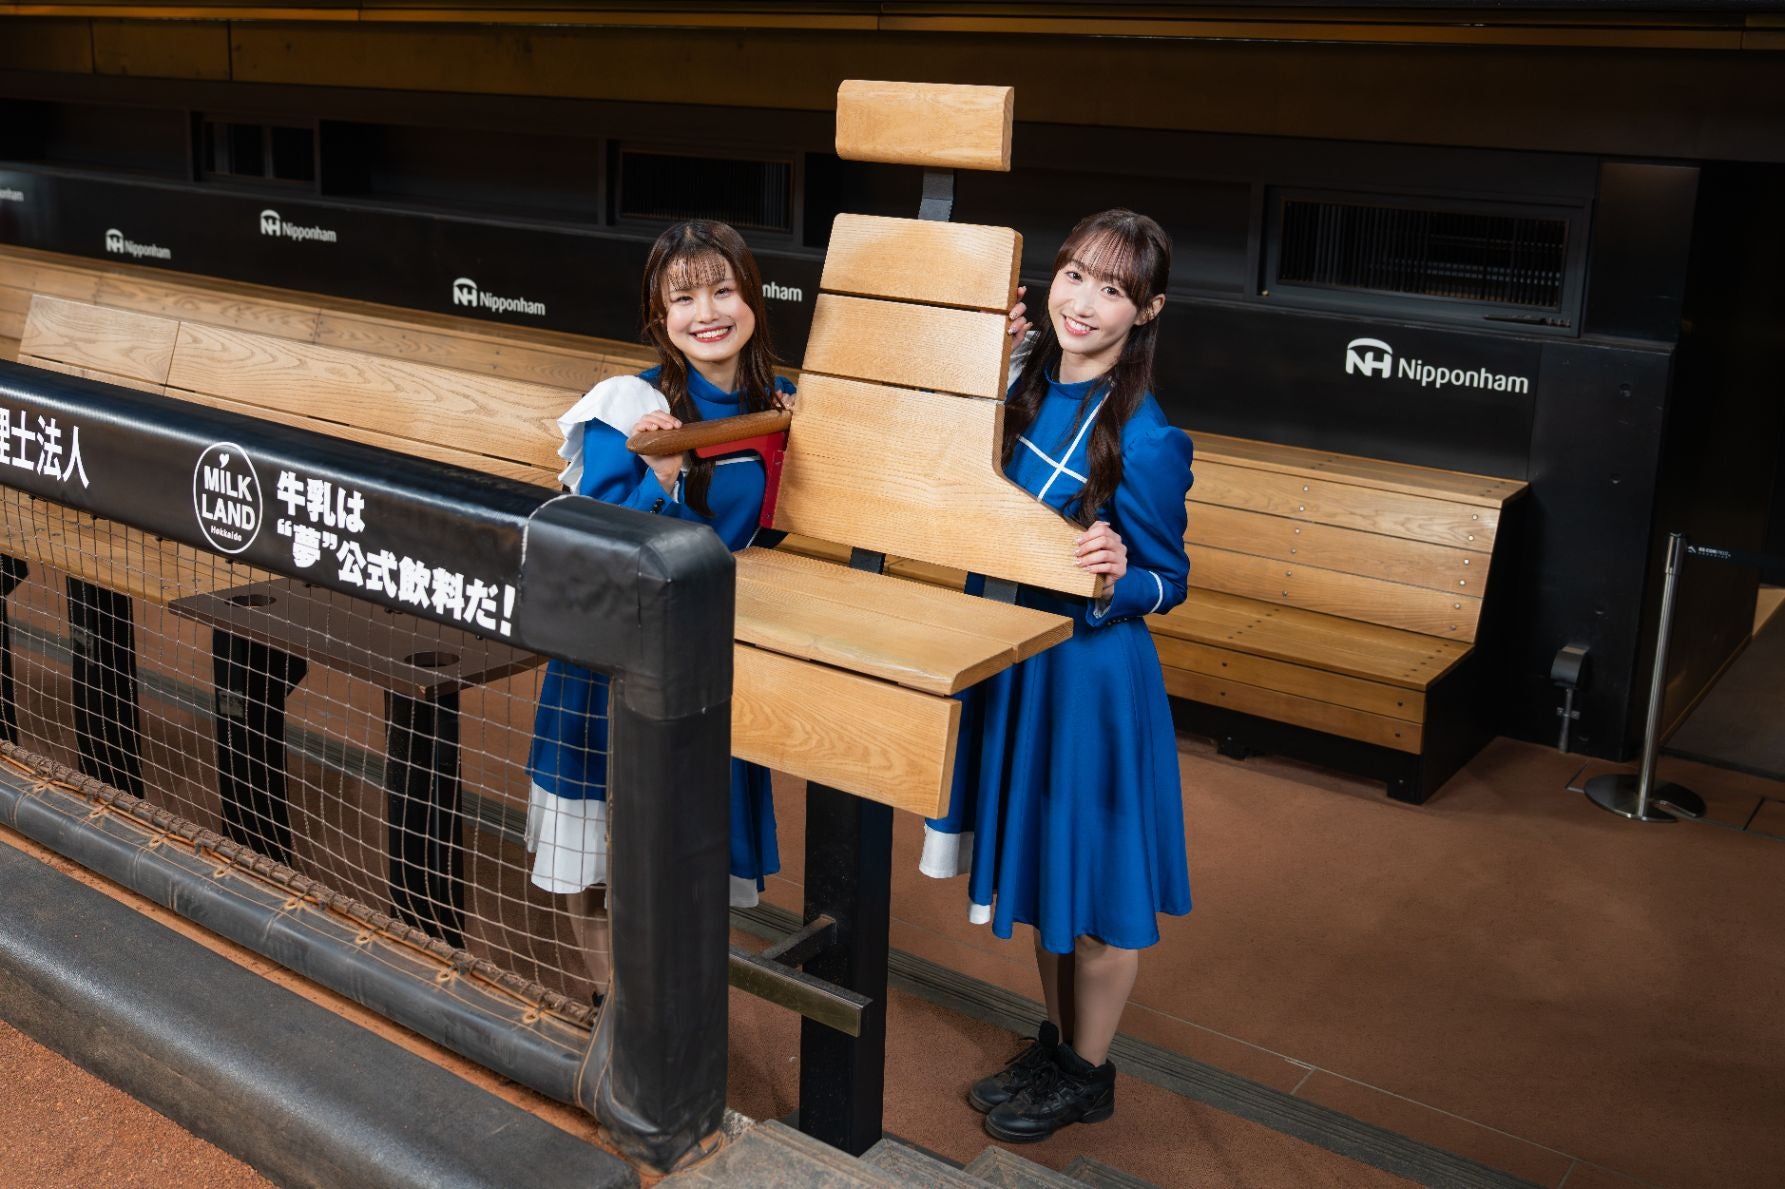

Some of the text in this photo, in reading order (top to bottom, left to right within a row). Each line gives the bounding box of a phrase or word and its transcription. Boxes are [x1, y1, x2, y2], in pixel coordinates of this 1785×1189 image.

[282, 222, 337, 242] Nipponham
[480, 291, 545, 316] Nipponham
[762, 281, 803, 302] nham
[1398, 357, 1529, 394] Nipponham
[204, 465, 253, 502] MILK
[202, 493, 256, 531] LAND
[277, 470, 365, 533] 牛乳は
[210, 525, 242, 541] Hokkaido
